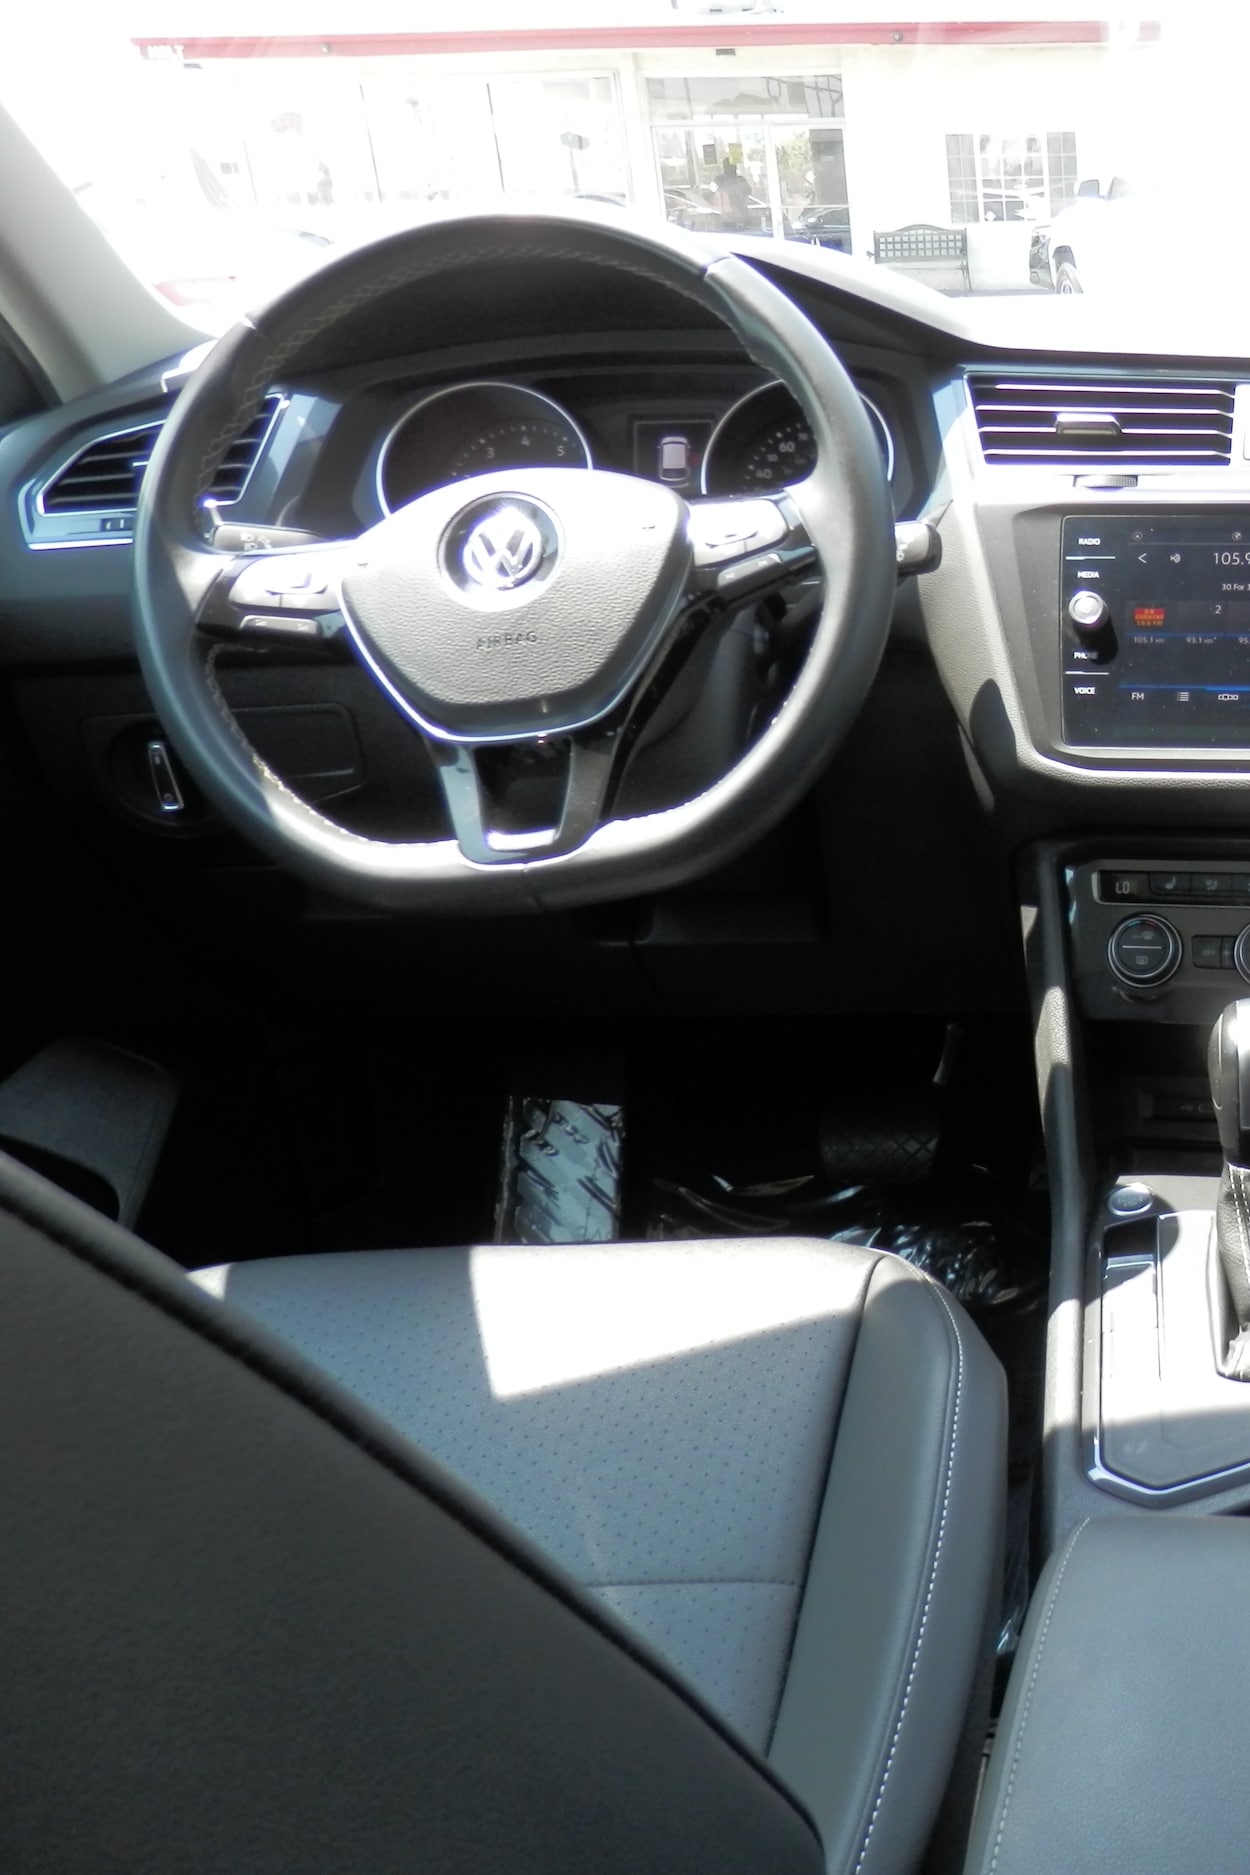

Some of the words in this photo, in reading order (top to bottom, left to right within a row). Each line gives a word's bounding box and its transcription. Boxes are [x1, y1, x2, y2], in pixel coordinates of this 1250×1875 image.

[778, 441, 796, 453] 60
[1078, 537, 1101, 546] RADIO
[1077, 570, 1100, 579] MEDIA
[1221, 583, 1232, 591] 30
[1233, 583, 1245, 591] For
[1215, 604, 1222, 615] 2
[475, 630, 538, 651] AIRBAG
[1133, 636, 1154, 644] 105.1
[1074, 686, 1096, 695] VOICE
[1131, 692, 1145, 701] FM
